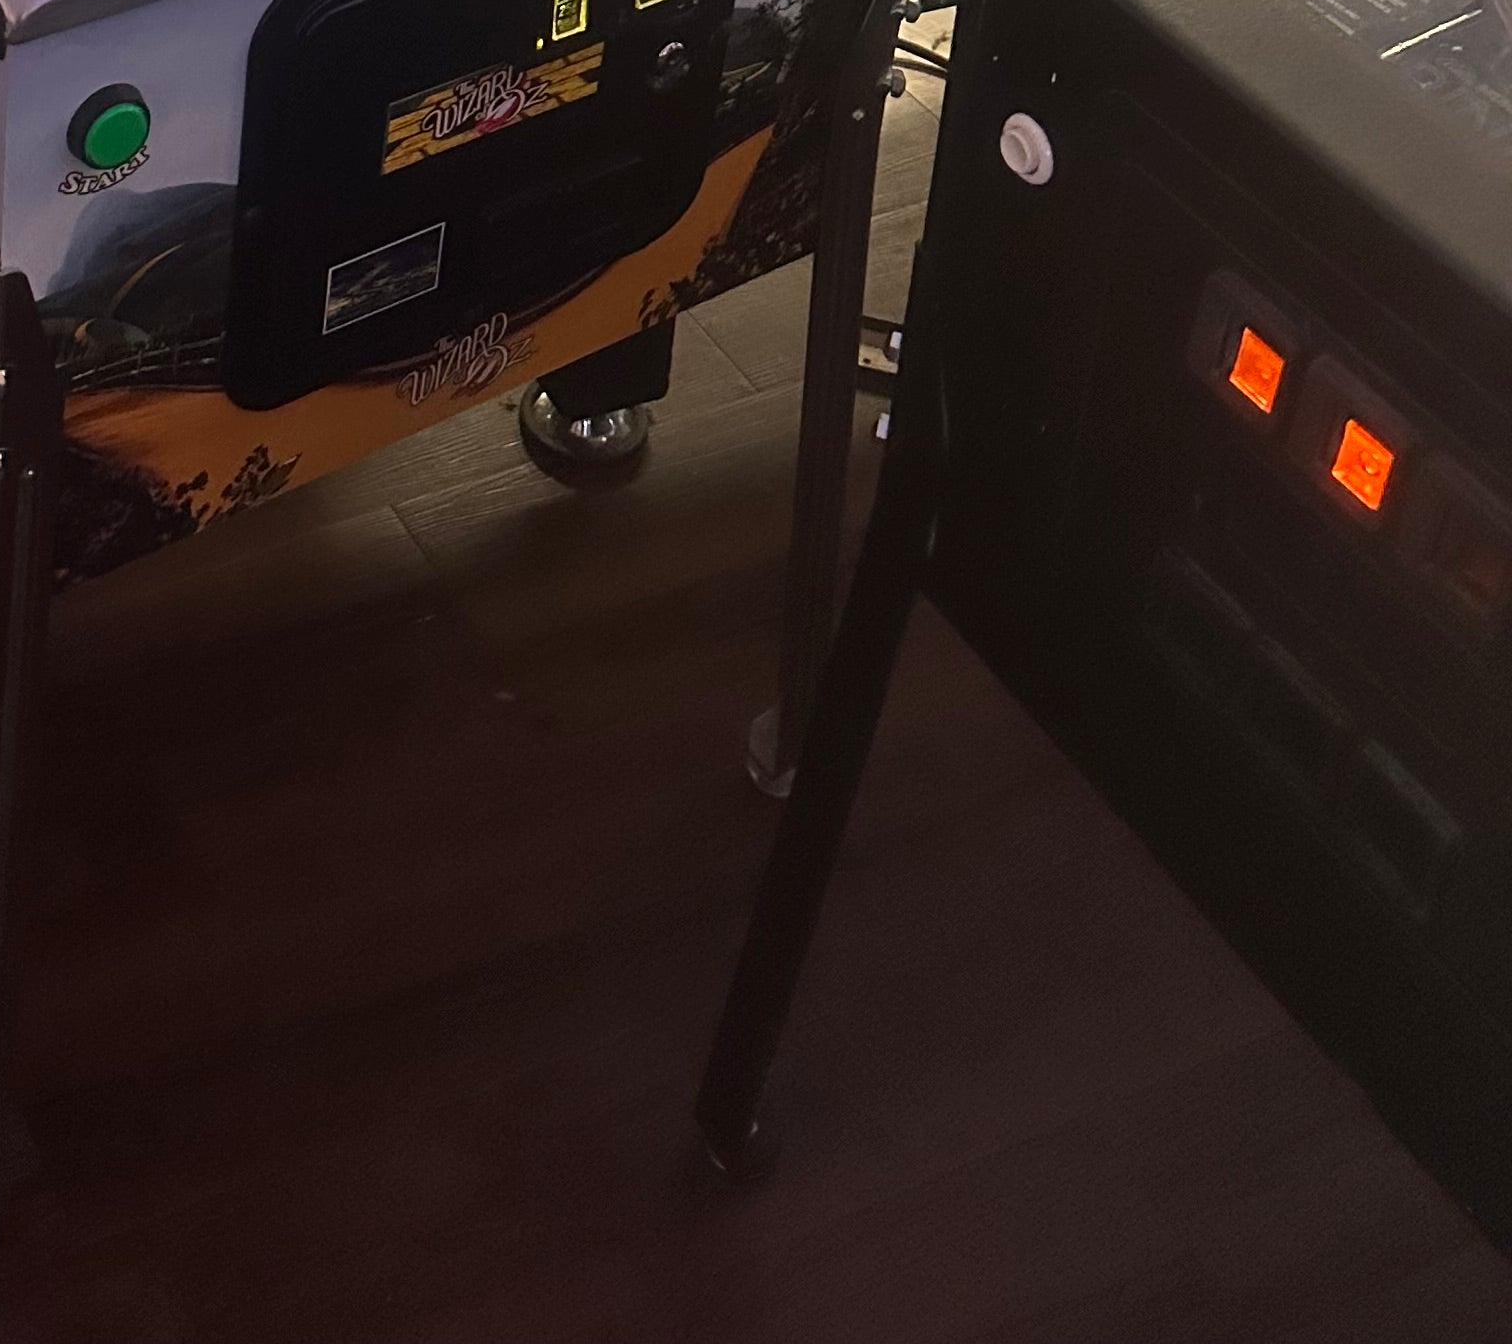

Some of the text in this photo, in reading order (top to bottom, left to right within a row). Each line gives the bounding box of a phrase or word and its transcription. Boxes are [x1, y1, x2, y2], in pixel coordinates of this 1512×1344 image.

[422, 64, 526, 139] WIZARD
[58, 144, 150, 196] START
[396, 312, 508, 406] WIZARD
